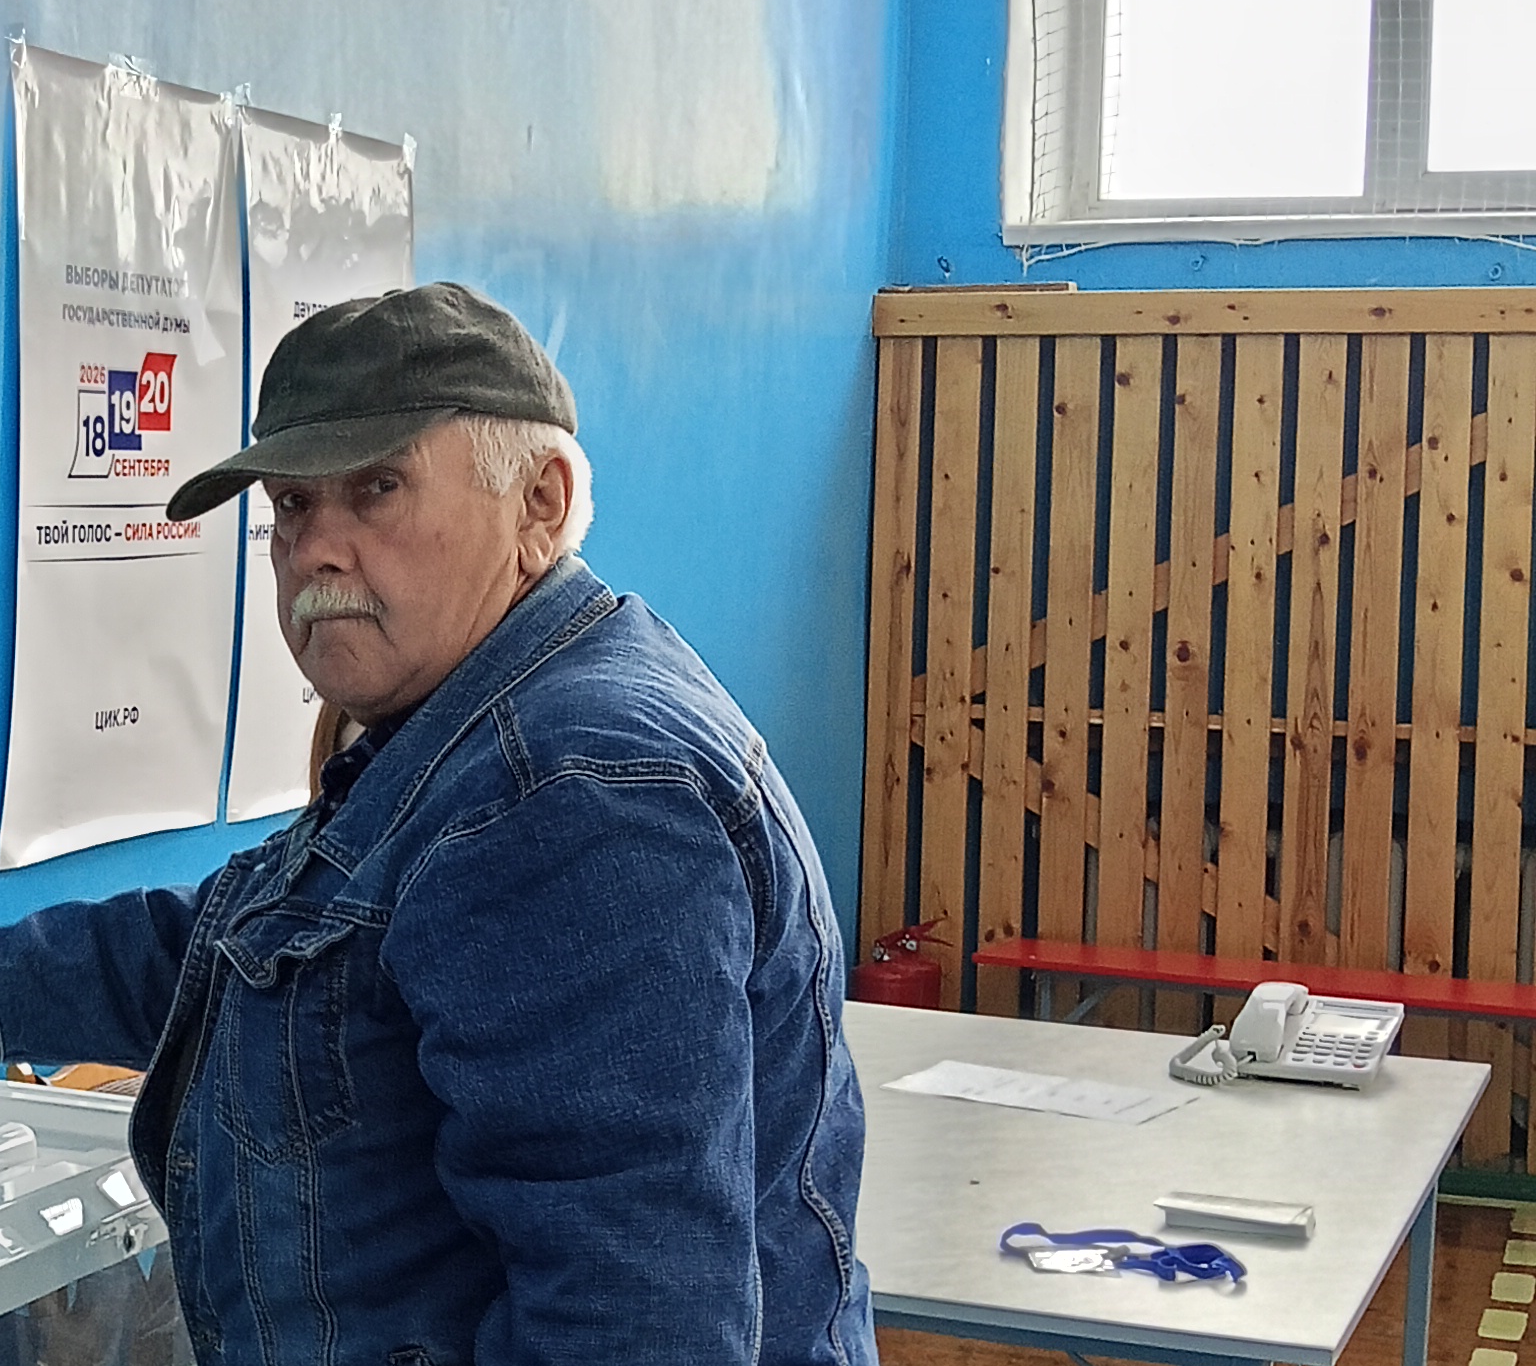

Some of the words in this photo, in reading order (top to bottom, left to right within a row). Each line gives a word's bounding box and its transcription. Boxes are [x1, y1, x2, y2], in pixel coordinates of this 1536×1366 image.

[66, 265, 119, 291] ВЫБОРЫ
[62, 304, 160, 332] ГОСУДАРСТВЕННОЙ
[162, 315, 190, 334] ДУМЫ
[79, 364, 106, 384] 2026
[83, 415, 106, 457] 18
[111, 390, 135, 434] 19
[140, 370, 169, 413] 20
[114, 458, 170, 477] СЕНТЯБРЯ
[36, 520, 69, 545] ТВОЙ
[72, 524, 112, 544] ГОЛОС
[124, 523, 154, 541] СИЛА
[156, 521, 201, 540] РОССИИ!
[95, 706, 139, 732] ЦИК.РФ
